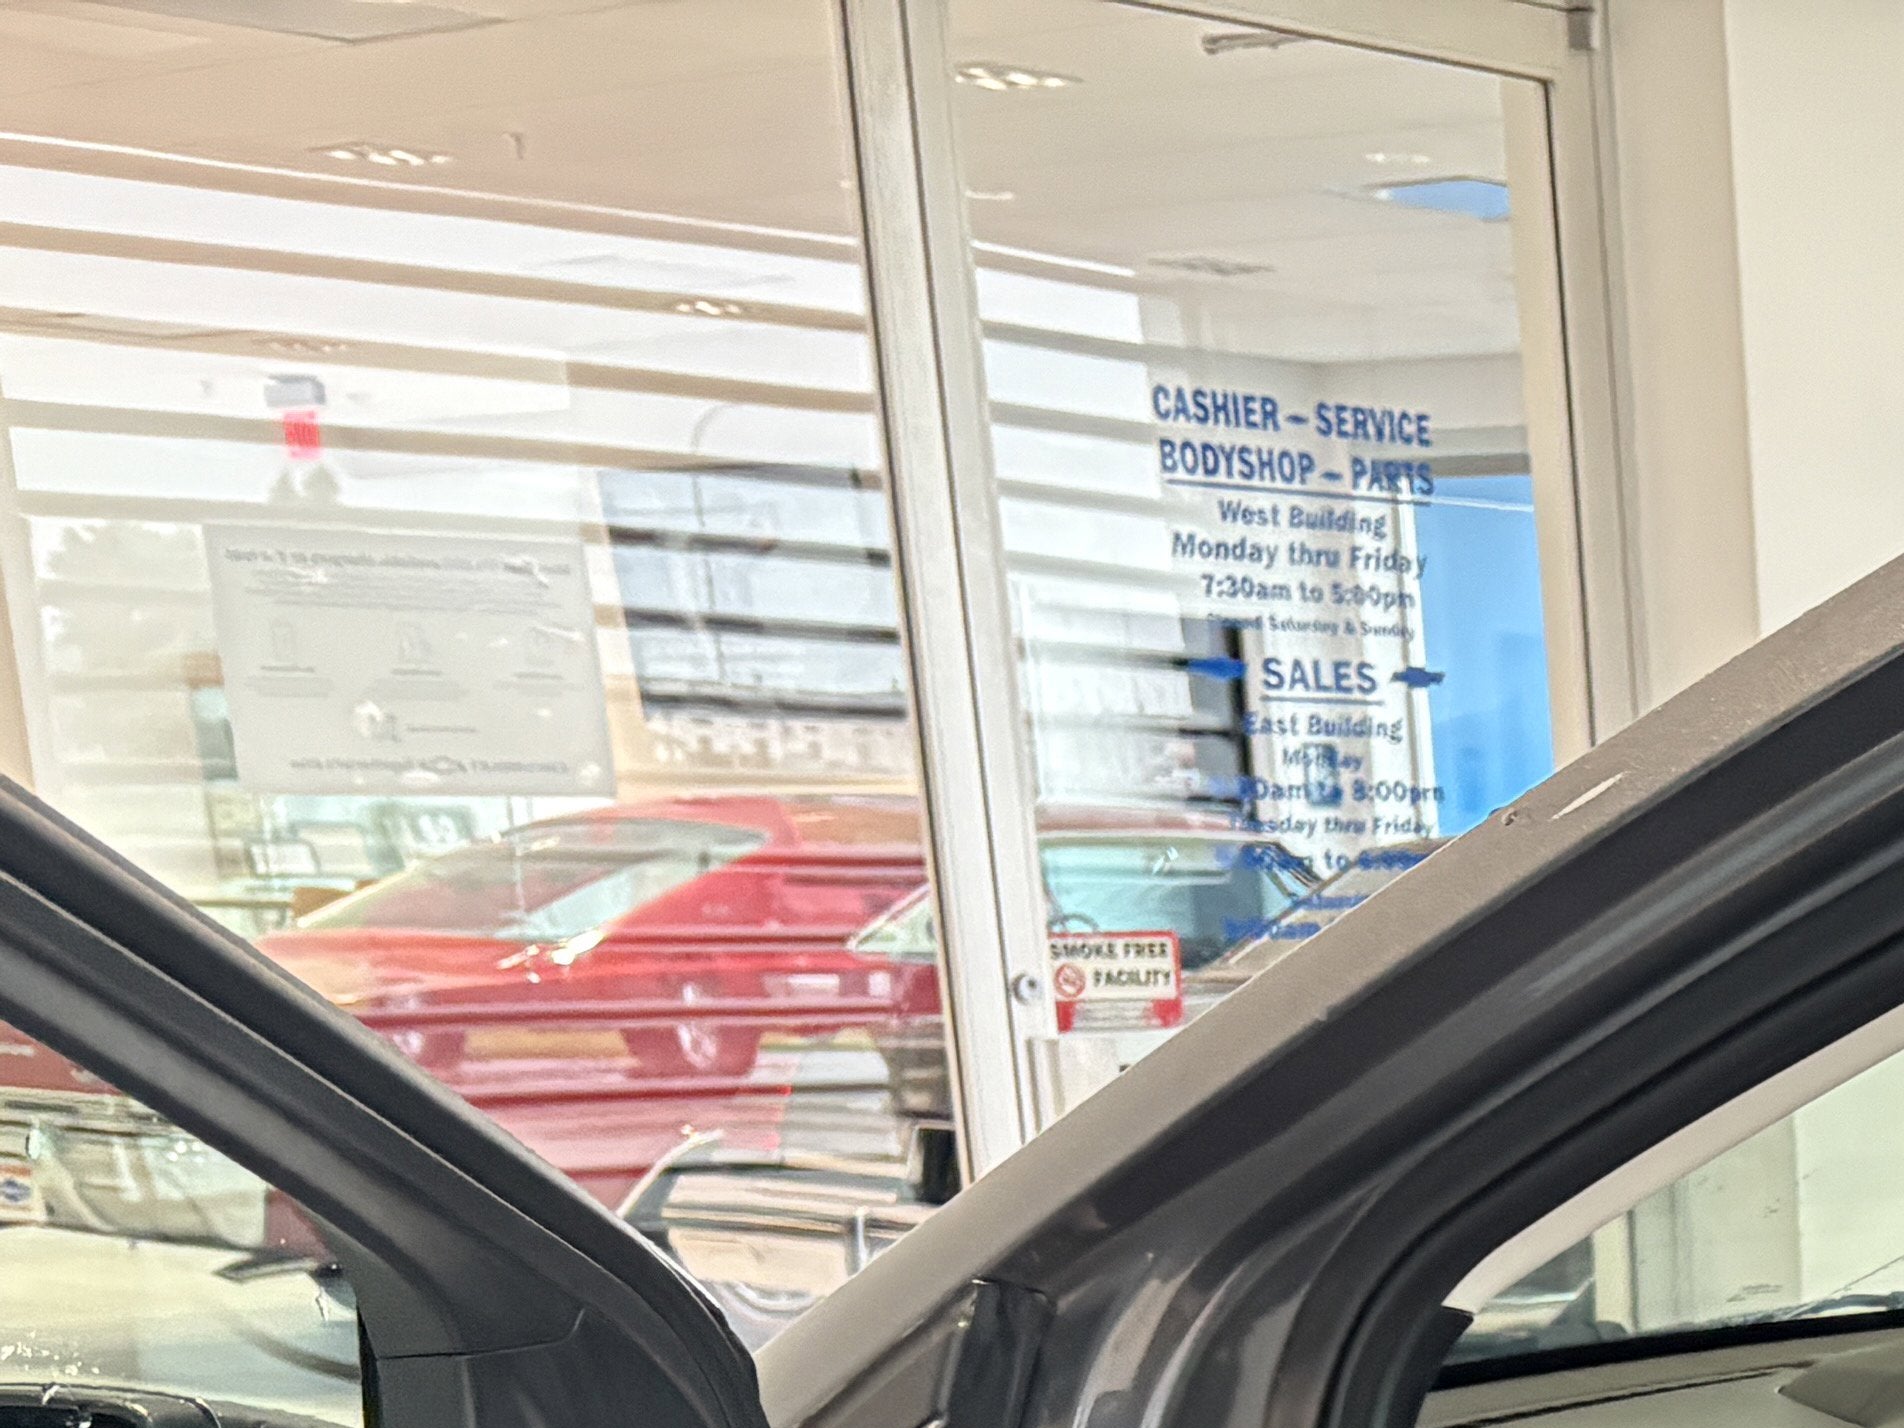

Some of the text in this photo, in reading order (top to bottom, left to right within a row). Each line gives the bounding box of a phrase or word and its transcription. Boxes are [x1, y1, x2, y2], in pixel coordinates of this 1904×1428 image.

[1152, 384, 1280, 432] CASHIER
[1315, 401, 1433, 448] SERVICE
[1159, 438, 1316, 485] BODYSHOP
[1351, 455, 1435, 496] PARTS
[1217, 499, 1388, 540] West Building
[1172, 532, 1428, 580] Monday thru Friday
[1201, 573, 1293, 602] 7:30am
[1299, 581, 1325, 604] to
[1261, 656, 1378, 695] SALES
[1243, 710, 1405, 745] East Building
[1324, 817, 1367, 836] thru
[1373, 817, 1434, 841] Friday
[1050, 941, 1168, 960] SMOKE FREE
[1093, 968, 1171, 988] FACILITY
